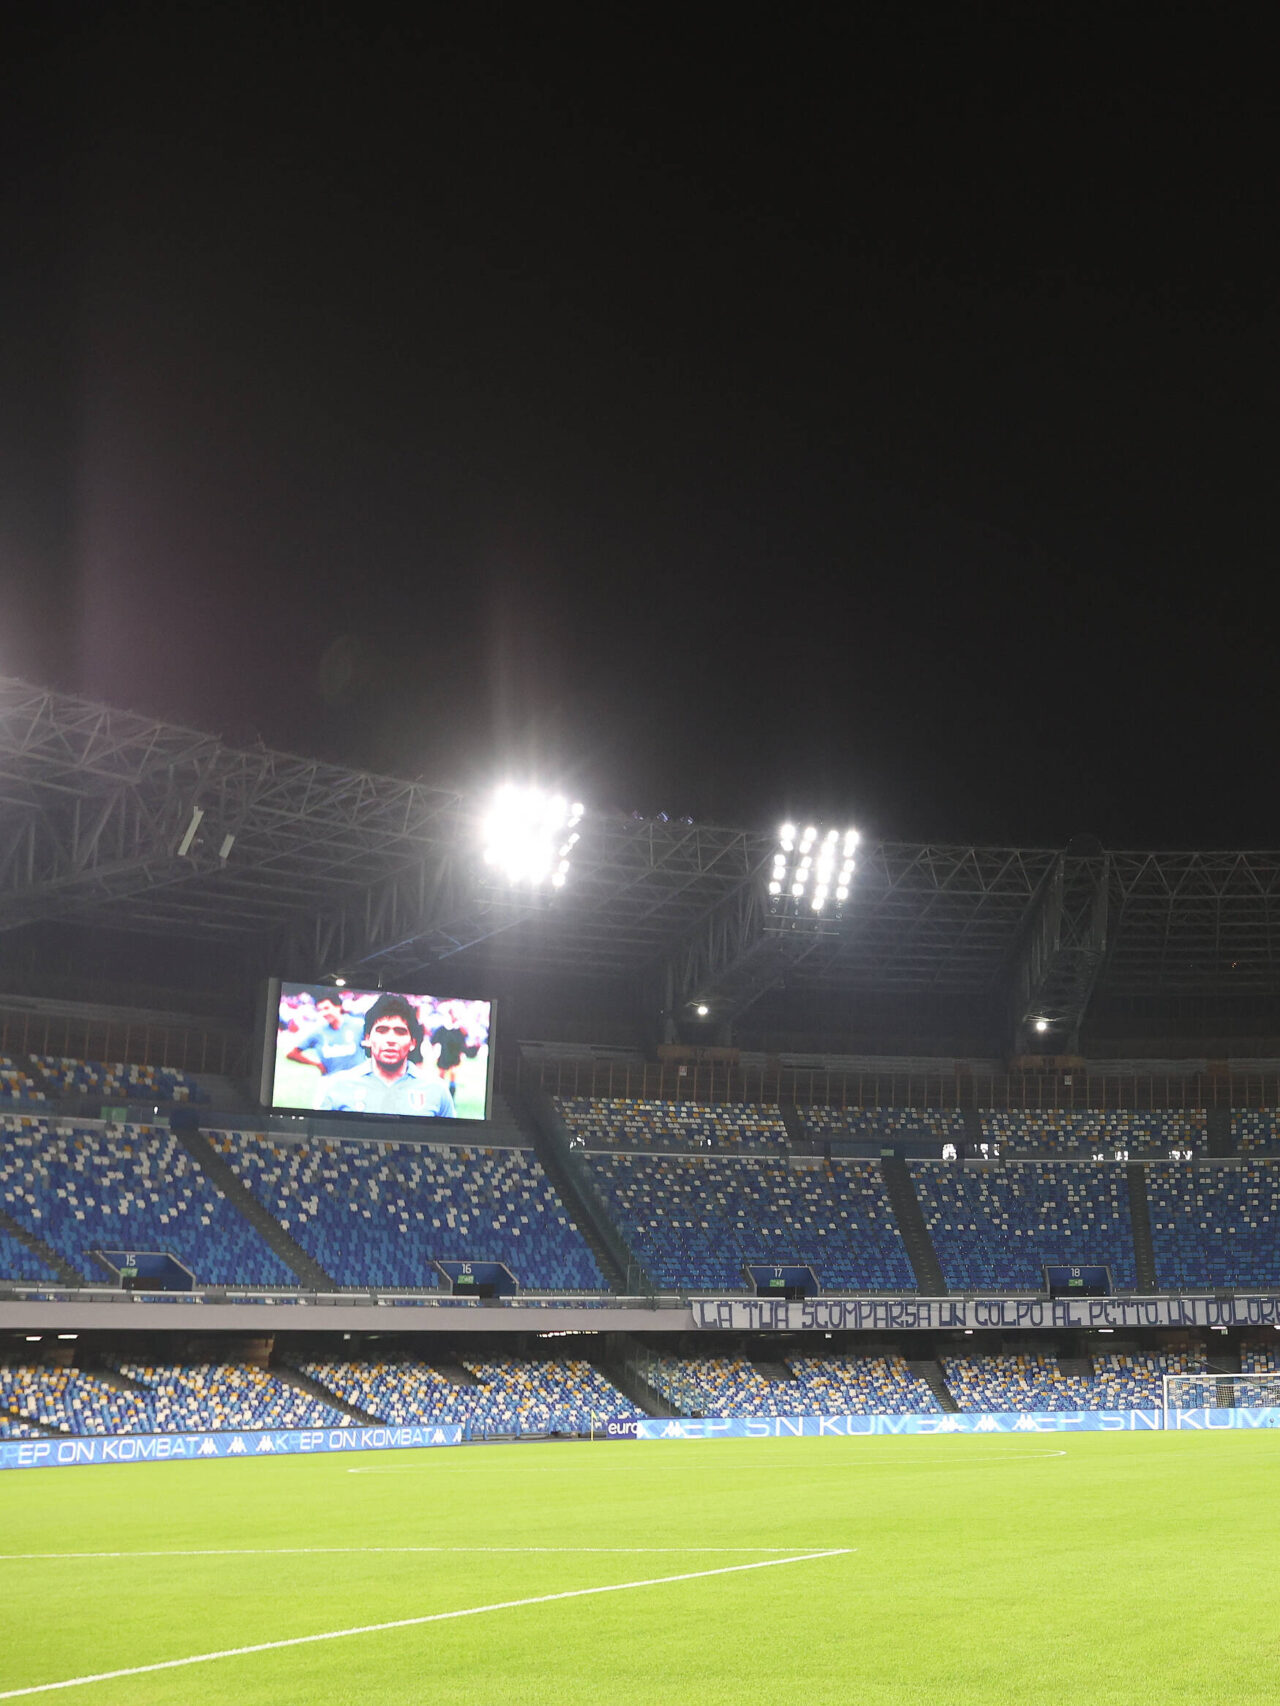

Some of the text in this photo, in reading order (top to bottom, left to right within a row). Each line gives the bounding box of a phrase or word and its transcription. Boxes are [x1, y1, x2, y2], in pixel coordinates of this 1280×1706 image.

[126, 1254, 136, 1267] 15
[461, 1263, 472, 1274] 16
[774, 1268, 783, 1278] 17
[1070, 1267, 1080, 1277] 18
[701, 1301, 733, 1328] LA
[743, 1301, 789, 1328] TUA
[802, 1301, 932, 1328] SCOMPARSA
[939, 1301, 967, 1327] UN
[974, 1301, 1044, 1327] COLPO
[1052, 1301, 1082, 1326] AL
[1168, 1301, 1196, 1325] UN
[329, 1430, 357, 1449] ON
[361, 1427, 433, 1448] KOMBAT
[58, 1441, 95, 1462] ON
[102, 1436, 200, 1460] KOMBAT
